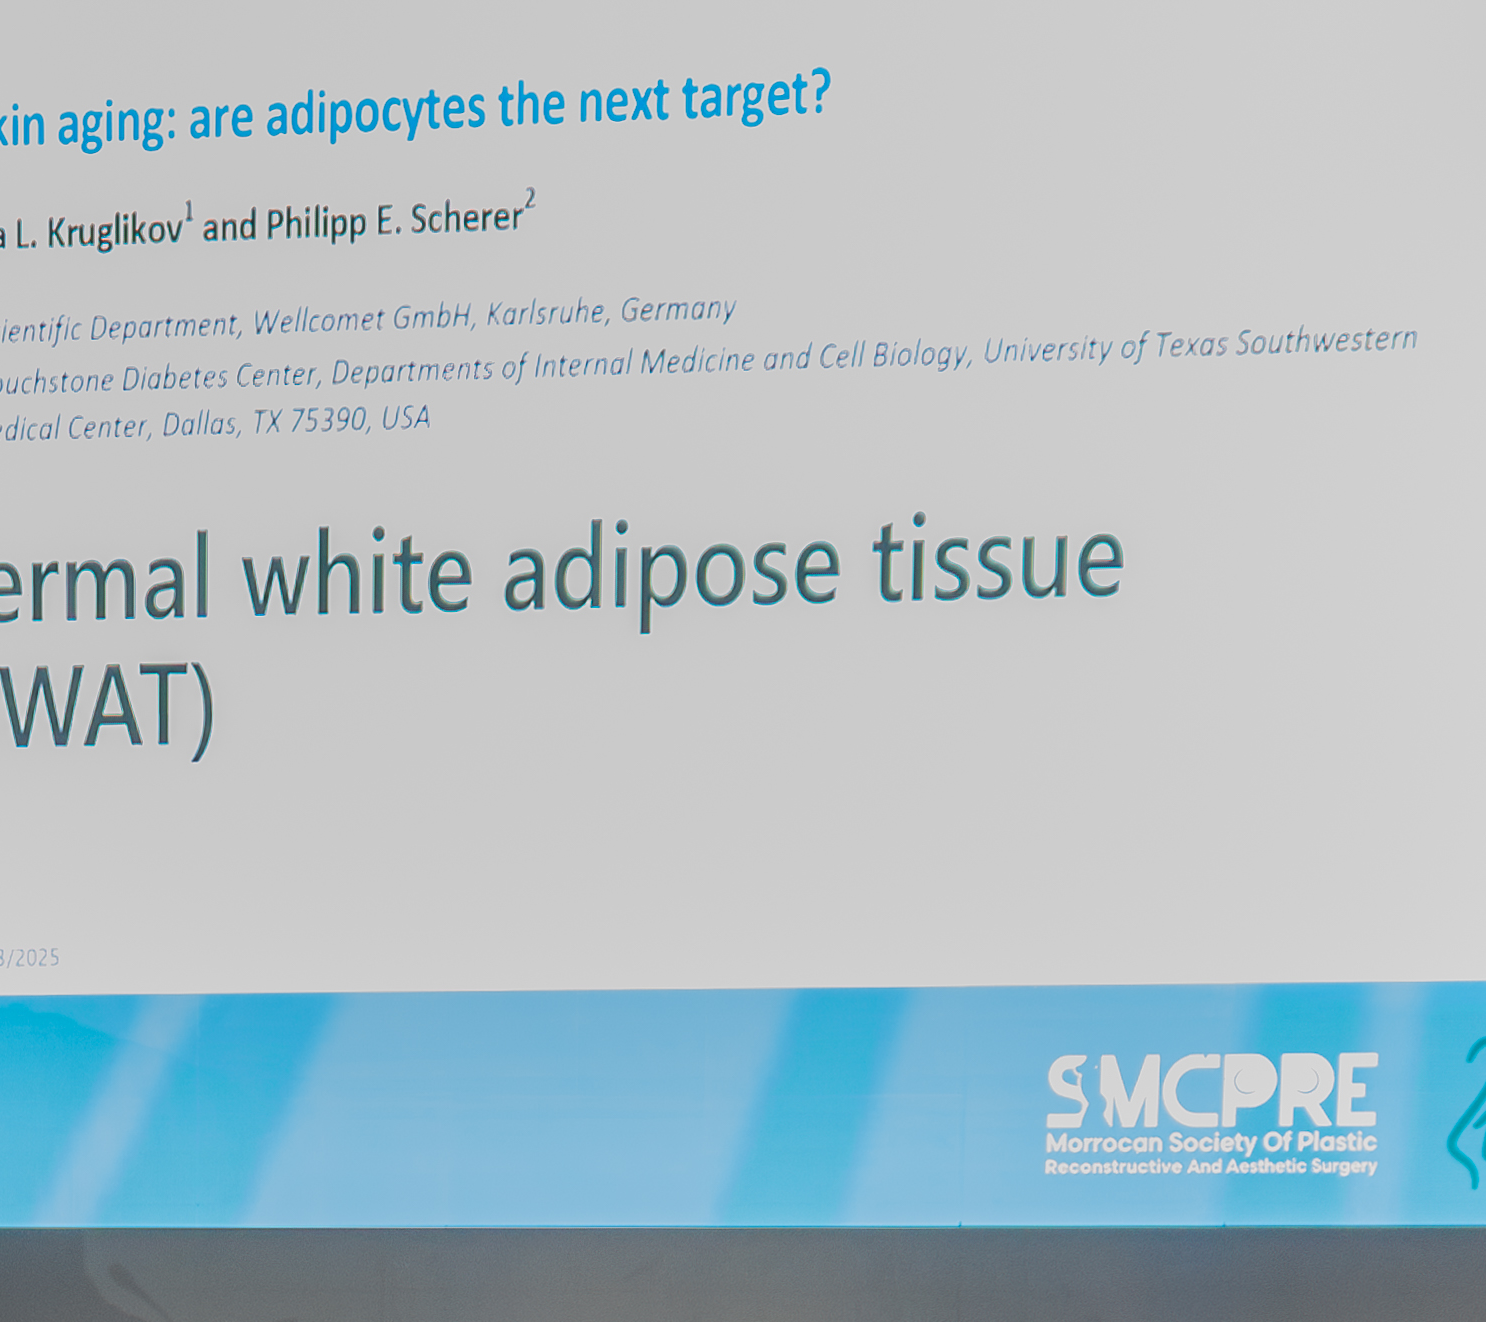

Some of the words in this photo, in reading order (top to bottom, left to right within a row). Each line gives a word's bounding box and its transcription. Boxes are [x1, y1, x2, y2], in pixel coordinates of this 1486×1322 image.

[59, 100, 175, 154] aging:
[190, 104, 253, 139] are
[267, 89, 485, 144] adipocytes
[498, 80, 565, 126] the
[581, 79, 669, 122] next
[682, 67, 831, 127] target?
[17, 219, 37, 249] L.
[203, 207, 256, 242] and
[268, 204, 366, 245] Philipp
[378, 205, 401, 235] E.
[91, 315, 242, 344] Department,
[255, 306, 385, 335] Wellcomet
[394, 301, 475, 331] GmbH,
[487, 297, 610, 326] Karlsruhe,
[622, 297, 736, 325] Germany
[123, 363, 227, 391] Diabetes
[237, 363, 321, 389] Center,
[332, 360, 494, 389] Departments
[502, 351, 528, 385] of
[535, 348, 633, 377] Internal
[641, 345, 754, 374] Medicine
[764, 342, 812, 371] and
[820, 340, 865, 368] Cell
[874, 338, 972, 372] Biology,
[985, 338, 1113, 366] University
[1121, 330, 1150, 365] of
[1157, 332, 1228, 357] Texas
[1236, 325, 1417, 356] Southwestern
[69, 415, 151, 441] Center,
[163, 409, 241, 438] Dallas,
[255, 409, 282, 434] TX
[292, 407, 371, 434] 75390,
[383, 405, 430, 430] USA
[242, 526, 472, 616] white
[504, 519, 840, 634] adipose
[872, 512, 1123, 602] tissue
[1046, 1052, 1379, 1128] SMCPRE
[1045, 1158, 1183, 1174] Reconstructive
[1187, 1158, 1222, 1174] And
[1225, 1156, 1307, 1175] Aesthetic
[1311, 1154, 1379, 1178] Surgery
[1046, 1133, 1163, 1154] Morrocan
[1168, 1131, 1258, 1158] Society
[1262, 1130, 1293, 1152] Of
[1297, 1129, 1379, 1153] Plastic
